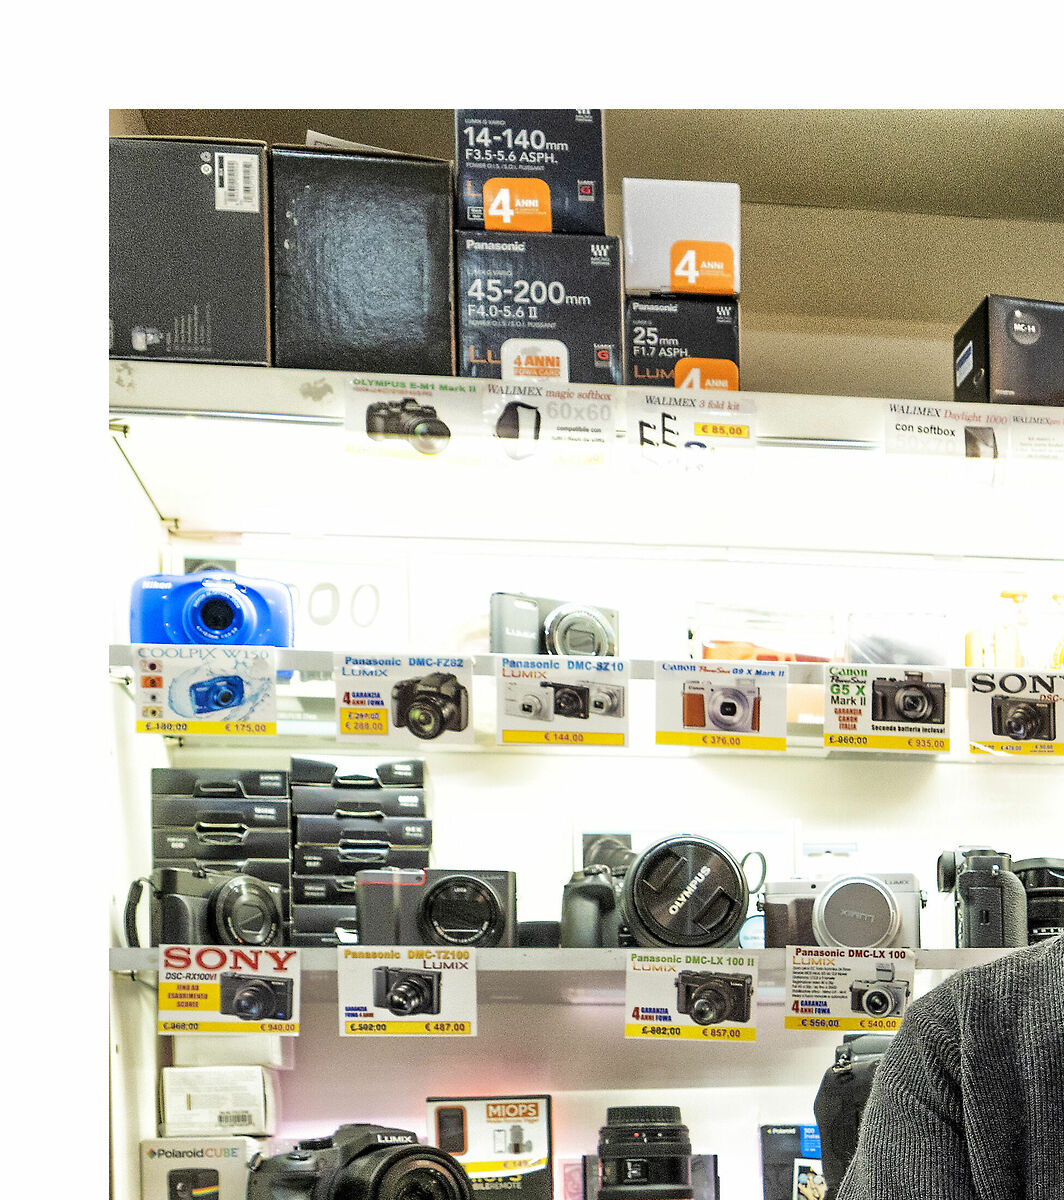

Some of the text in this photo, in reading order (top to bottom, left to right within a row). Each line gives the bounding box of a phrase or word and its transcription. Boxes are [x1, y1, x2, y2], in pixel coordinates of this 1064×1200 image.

[465, 149, 558, 164] F3.5-5.6 ASPH.
[488, 188, 539, 223] 4 ANNI
[466, 240, 526, 252] Panasonic
[674, 250, 724, 284] 4 ANNI
[467, 280, 591, 306] 45-200mm
[632, 302, 678, 313] Panasonic
[632, 327, 679, 346] 25mm
[633, 346, 690, 358] F1.7 ASPH.
[704, 378, 729, 388] ANNI
[487, 384, 612, 401] WALIMEX magic softbox
[644, 394, 697, 408] WALIMEX
[727, 401, 740, 411] kit
[888, 402, 1009, 425] WALIMEX Daylight 1000
[895, 422, 956, 437] con softbox
[137, 647, 218, 660] COOLPIX
[344, 656, 465, 668] Panasonic DMC-FZ82
[502, 657, 625, 672] Panasonic DMC-SZ10
[341, 666, 389, 677] LUMIX
[502, 669, 548, 680] LUMIX
[829, 666, 868, 678] Canon
[830, 684, 866, 696] G5 X
[884, 878, 910, 886] LUMIX
[668, 865, 713, 916] OLYMPUS
[344, 949, 470, 961] Panasonic DMC-TZ100
[795, 947, 906, 959] Panasonic DMC-LX 100
[163, 947, 298, 972] SONY
[422, 960, 470, 970] LUMIX
[631, 953, 682, 964] Panasonic
[685, 955, 724, 966] DMC-LX
[726, 957, 745, 967] 100
[792, 956, 836, 967] LUMIX
[632, 961, 677, 973] LUMIX
[792, 1000, 828, 1012] 4 GARANZIA
[632, 1007, 669, 1020] 4 GARANZIA
[487, 1104, 538, 1118] MIOPS
[773, 1127, 796, 1135] Polaroid
[377, 1133, 413, 1145] LUMIX
[157, 1147, 238, 1159] Polaroid CUBE
